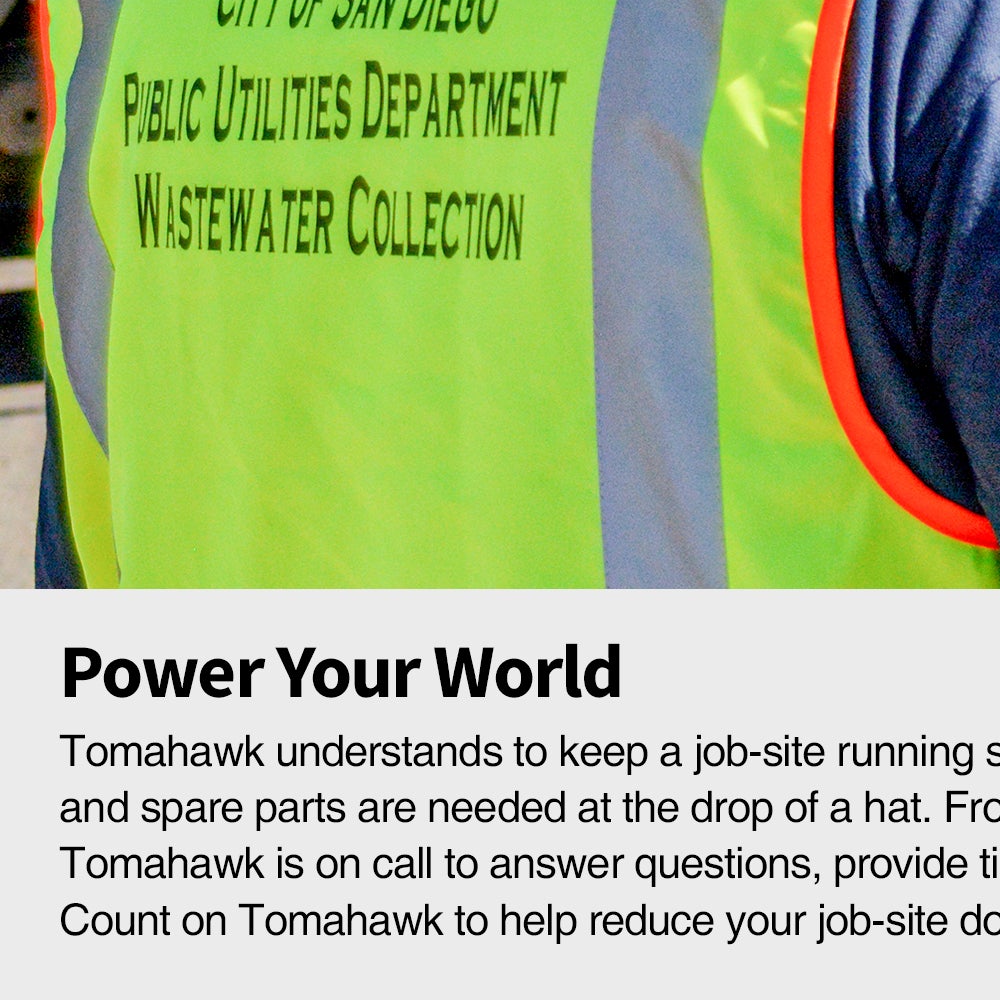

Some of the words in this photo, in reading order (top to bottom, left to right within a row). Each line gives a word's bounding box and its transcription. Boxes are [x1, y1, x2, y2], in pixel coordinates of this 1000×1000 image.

[123, 71, 206, 147] PUBLIC
[213, 64, 352, 143] UTILITIES
[361, 60, 568, 140] DEPARTMENT
[134, 172, 334, 255] WASTEWATER
[347, 175, 525, 261] COLLECTION
